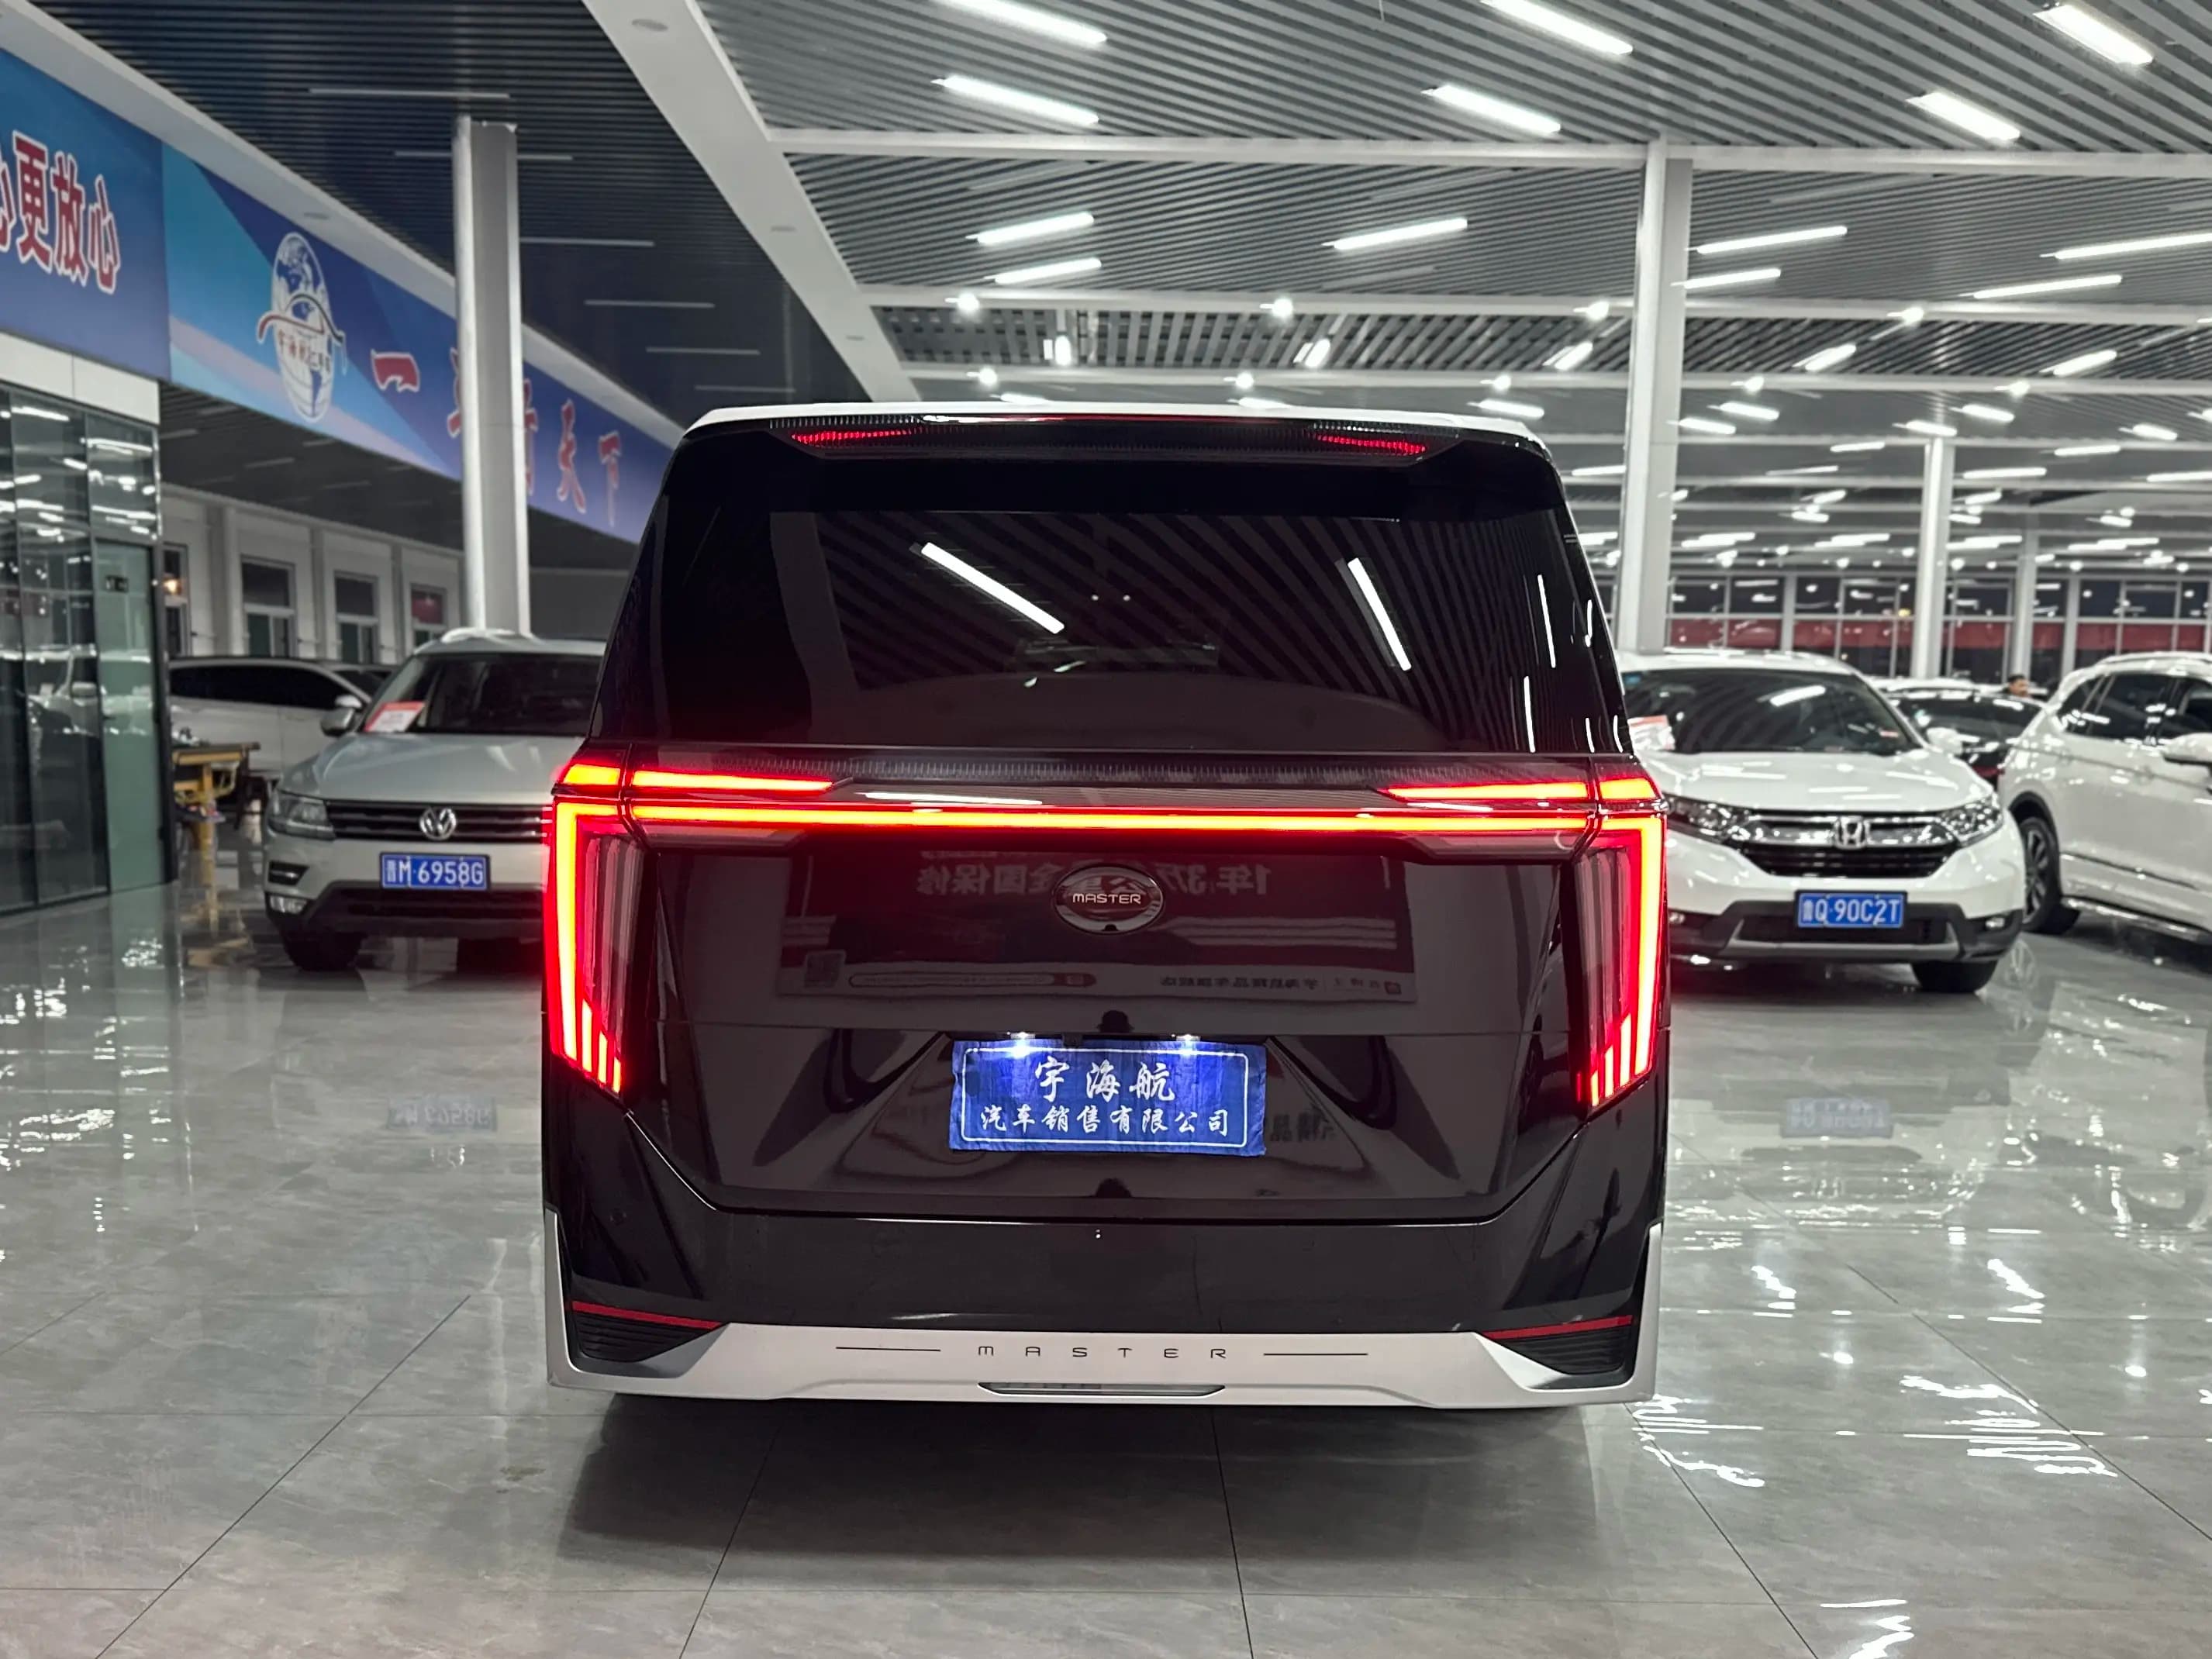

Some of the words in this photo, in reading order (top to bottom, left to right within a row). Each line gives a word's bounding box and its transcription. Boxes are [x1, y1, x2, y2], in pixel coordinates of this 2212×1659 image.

[1072, 893, 1142, 905] MASTER
[1035, 1054, 1176, 1102] 宇海航
[980, 1105, 1230, 1137] 汽车销售有限公司
[978, 1345, 1227, 1359] MASTER
